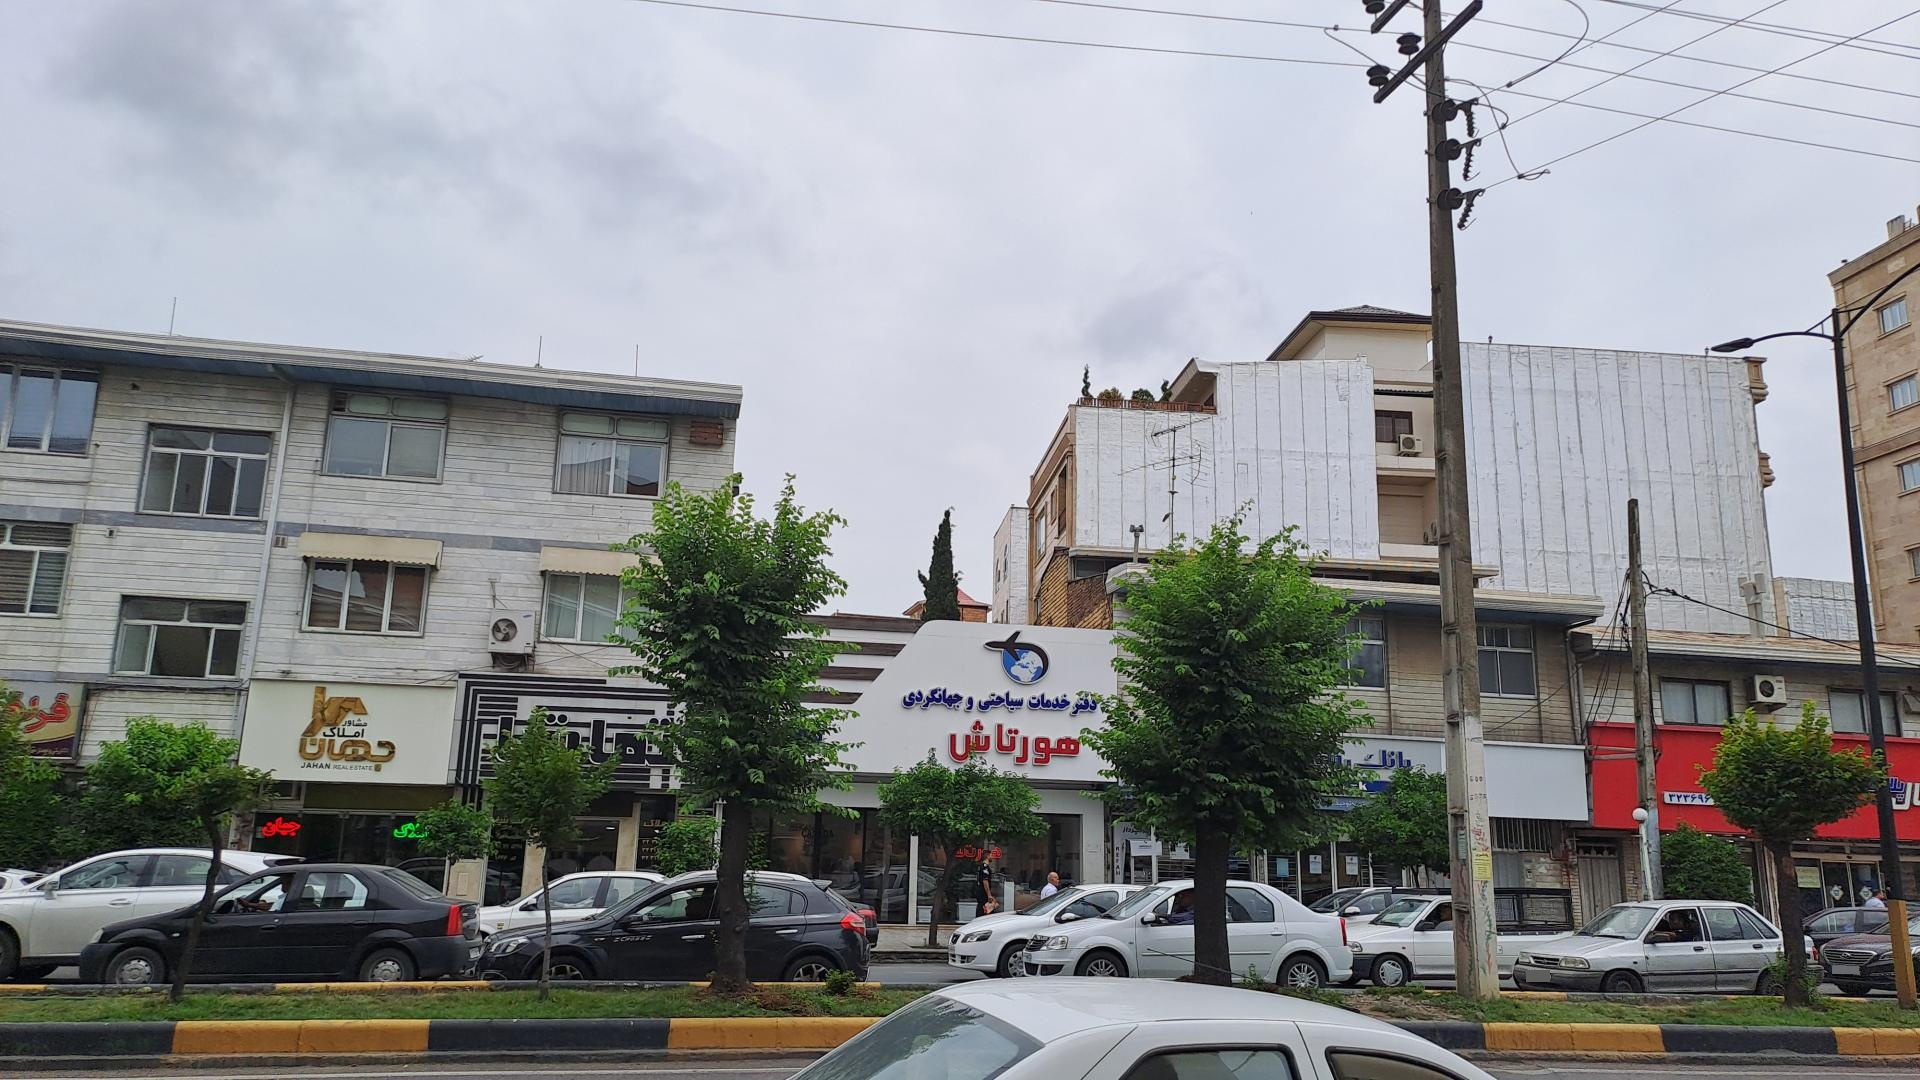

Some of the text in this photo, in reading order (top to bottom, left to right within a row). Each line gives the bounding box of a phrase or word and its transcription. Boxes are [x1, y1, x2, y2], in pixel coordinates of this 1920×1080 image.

[902, 687, 1098, 716] دفتر خدمات سیاحتی و جهانگردی
[341, 718, 368, 727] مشاور
[322, 727, 365, 738] املاک
[949, 719, 1081, 766] هورتاش
[301, 762, 331, 770] JAHAN
[1668, 793, 1712, 803] ۳۲۳۶۹۶
[262, 816, 301, 837] جهان
